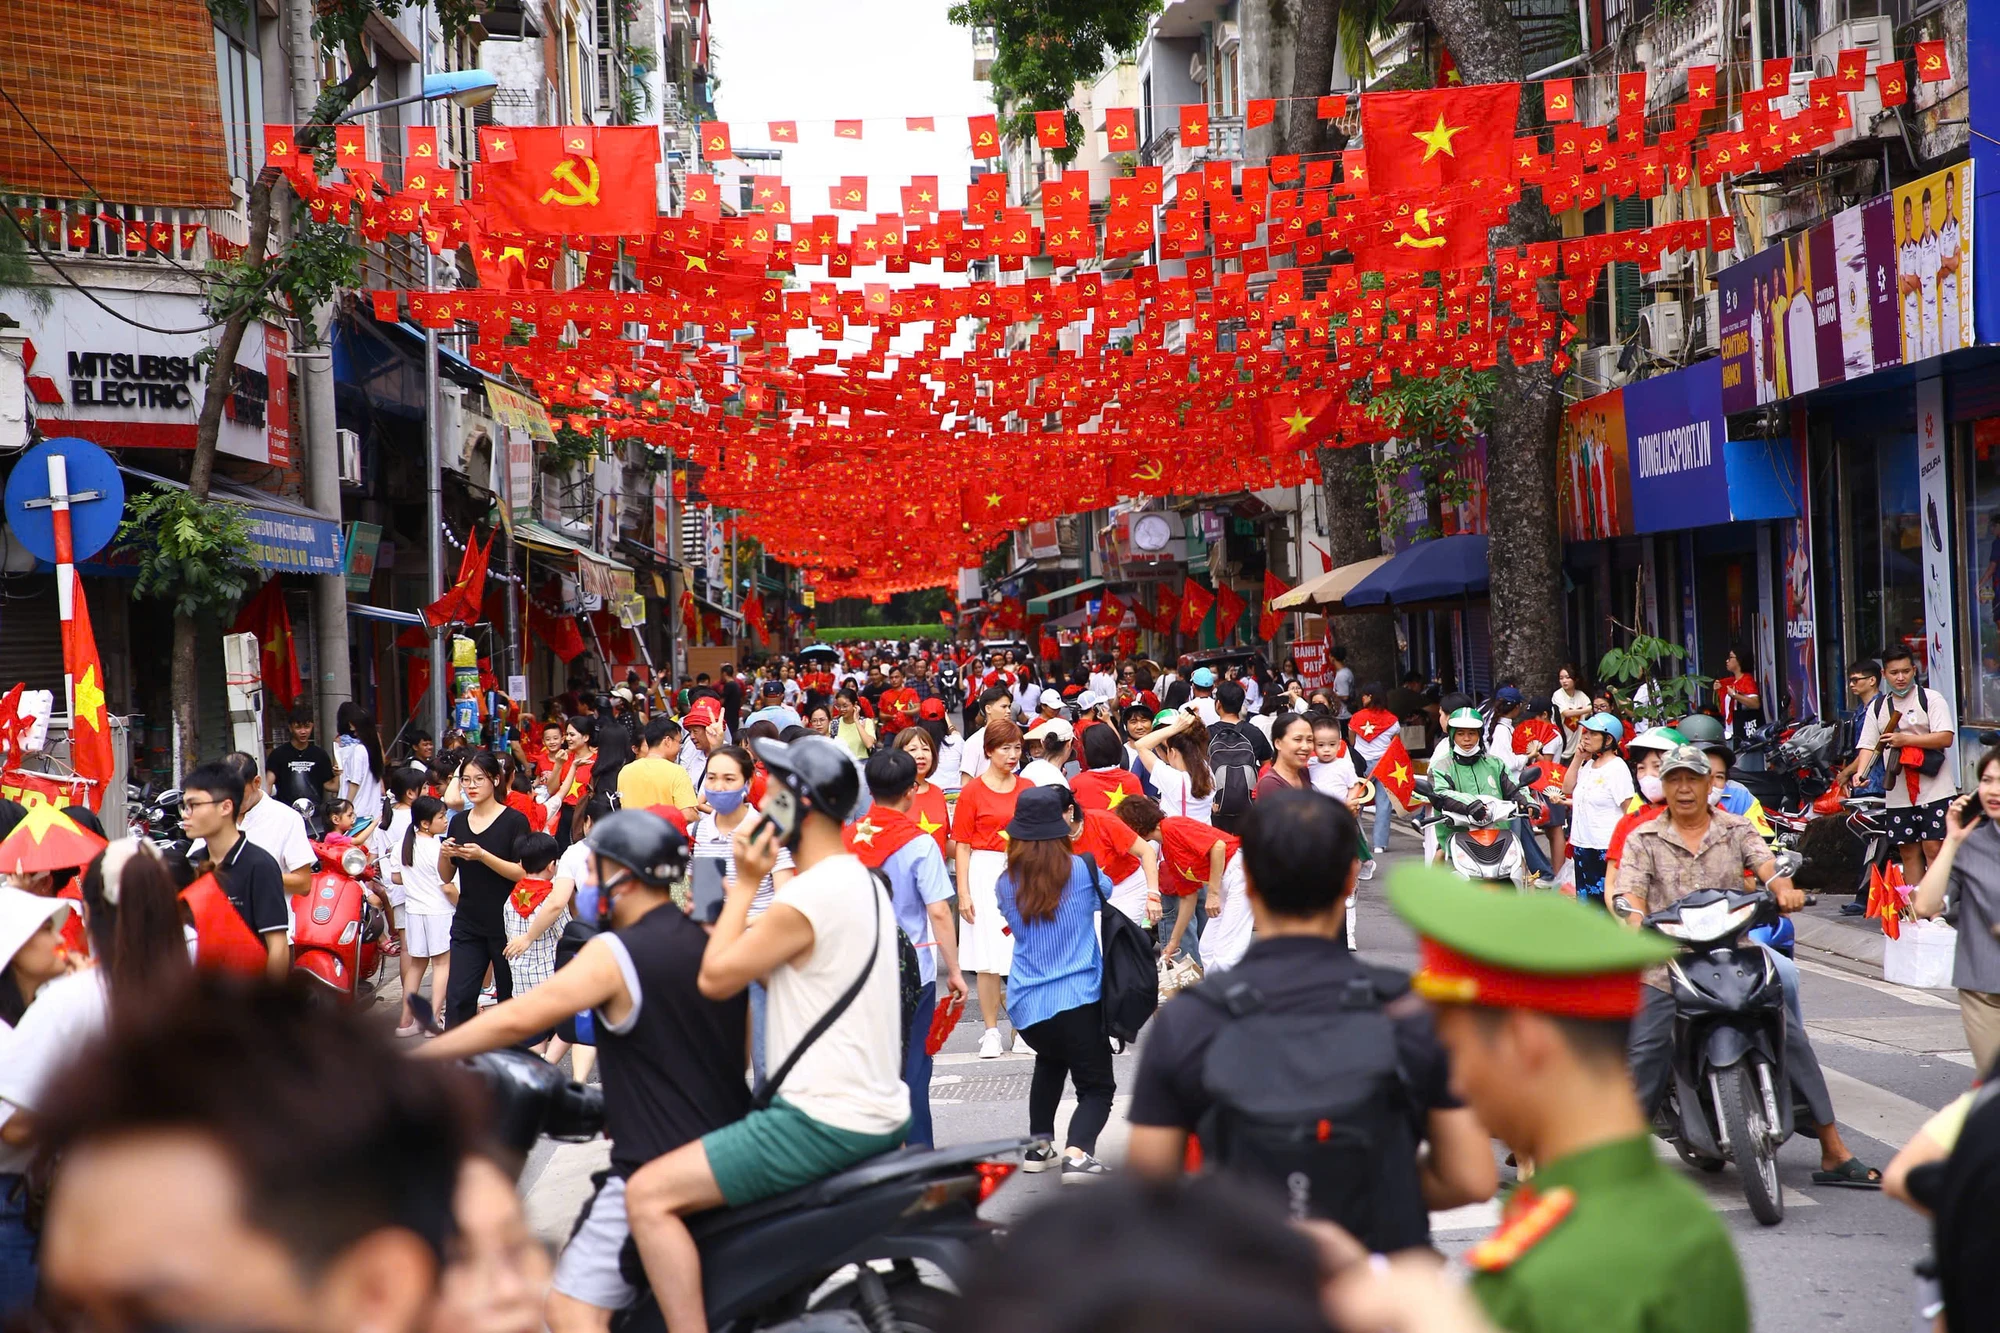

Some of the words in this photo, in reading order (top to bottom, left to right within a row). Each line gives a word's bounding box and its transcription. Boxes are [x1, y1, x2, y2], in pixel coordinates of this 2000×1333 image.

[1816, 286, 1834, 304] CONTRAS
[1817, 302, 1837, 327] HANOI
[1721, 330, 1748, 360] CONTRAS
[67, 351, 201, 383] MITSUBISH
[1723, 362, 1741, 389] HANOI
[71, 379, 191, 410] ELECTRIC
[1638, 420, 1711, 479] DONGLUCSPORT.VN
[1921, 454, 1941, 477] ENDURA
[1787, 620, 1813, 639] RACER
[1744, 719, 1757, 729] JUST
